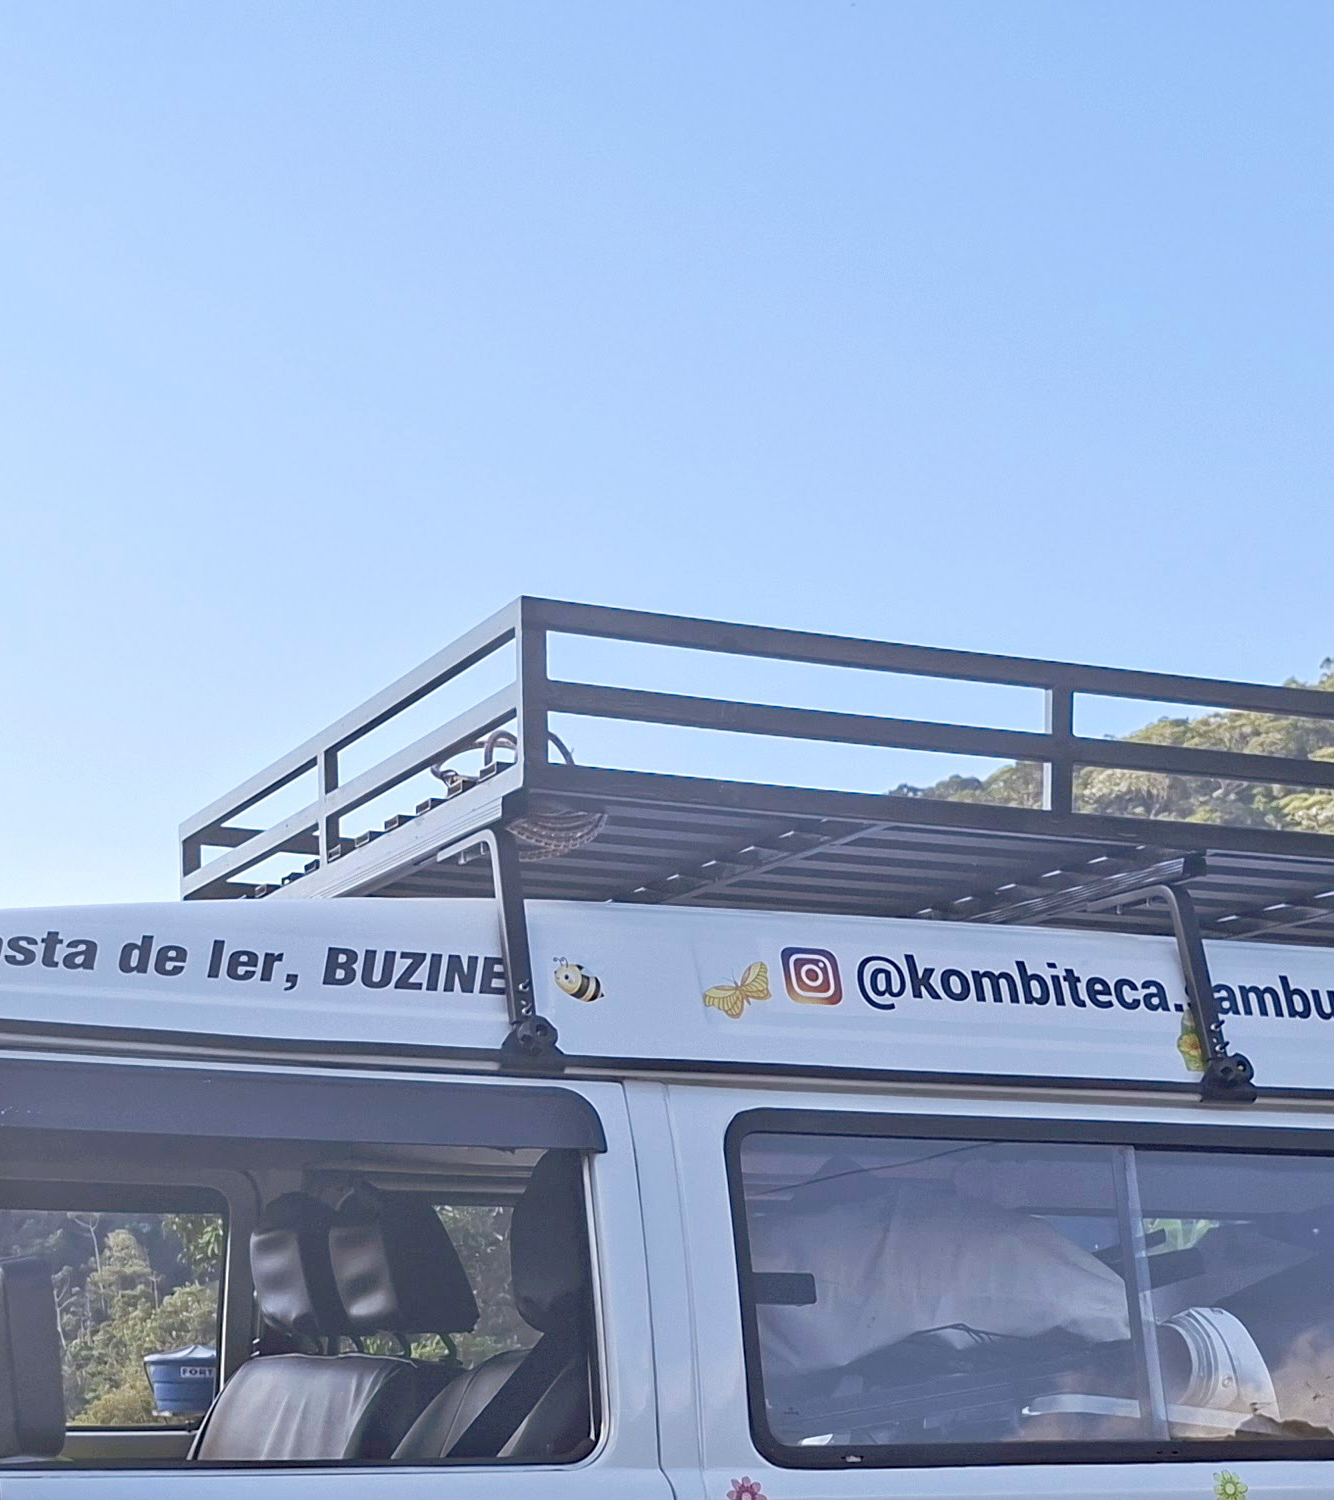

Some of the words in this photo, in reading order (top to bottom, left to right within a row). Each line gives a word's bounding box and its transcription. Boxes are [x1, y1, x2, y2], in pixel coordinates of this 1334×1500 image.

[118, 934, 188, 977] de
[206, 939, 299, 992] ler,
[322, 946, 508, 996] BUZINE
